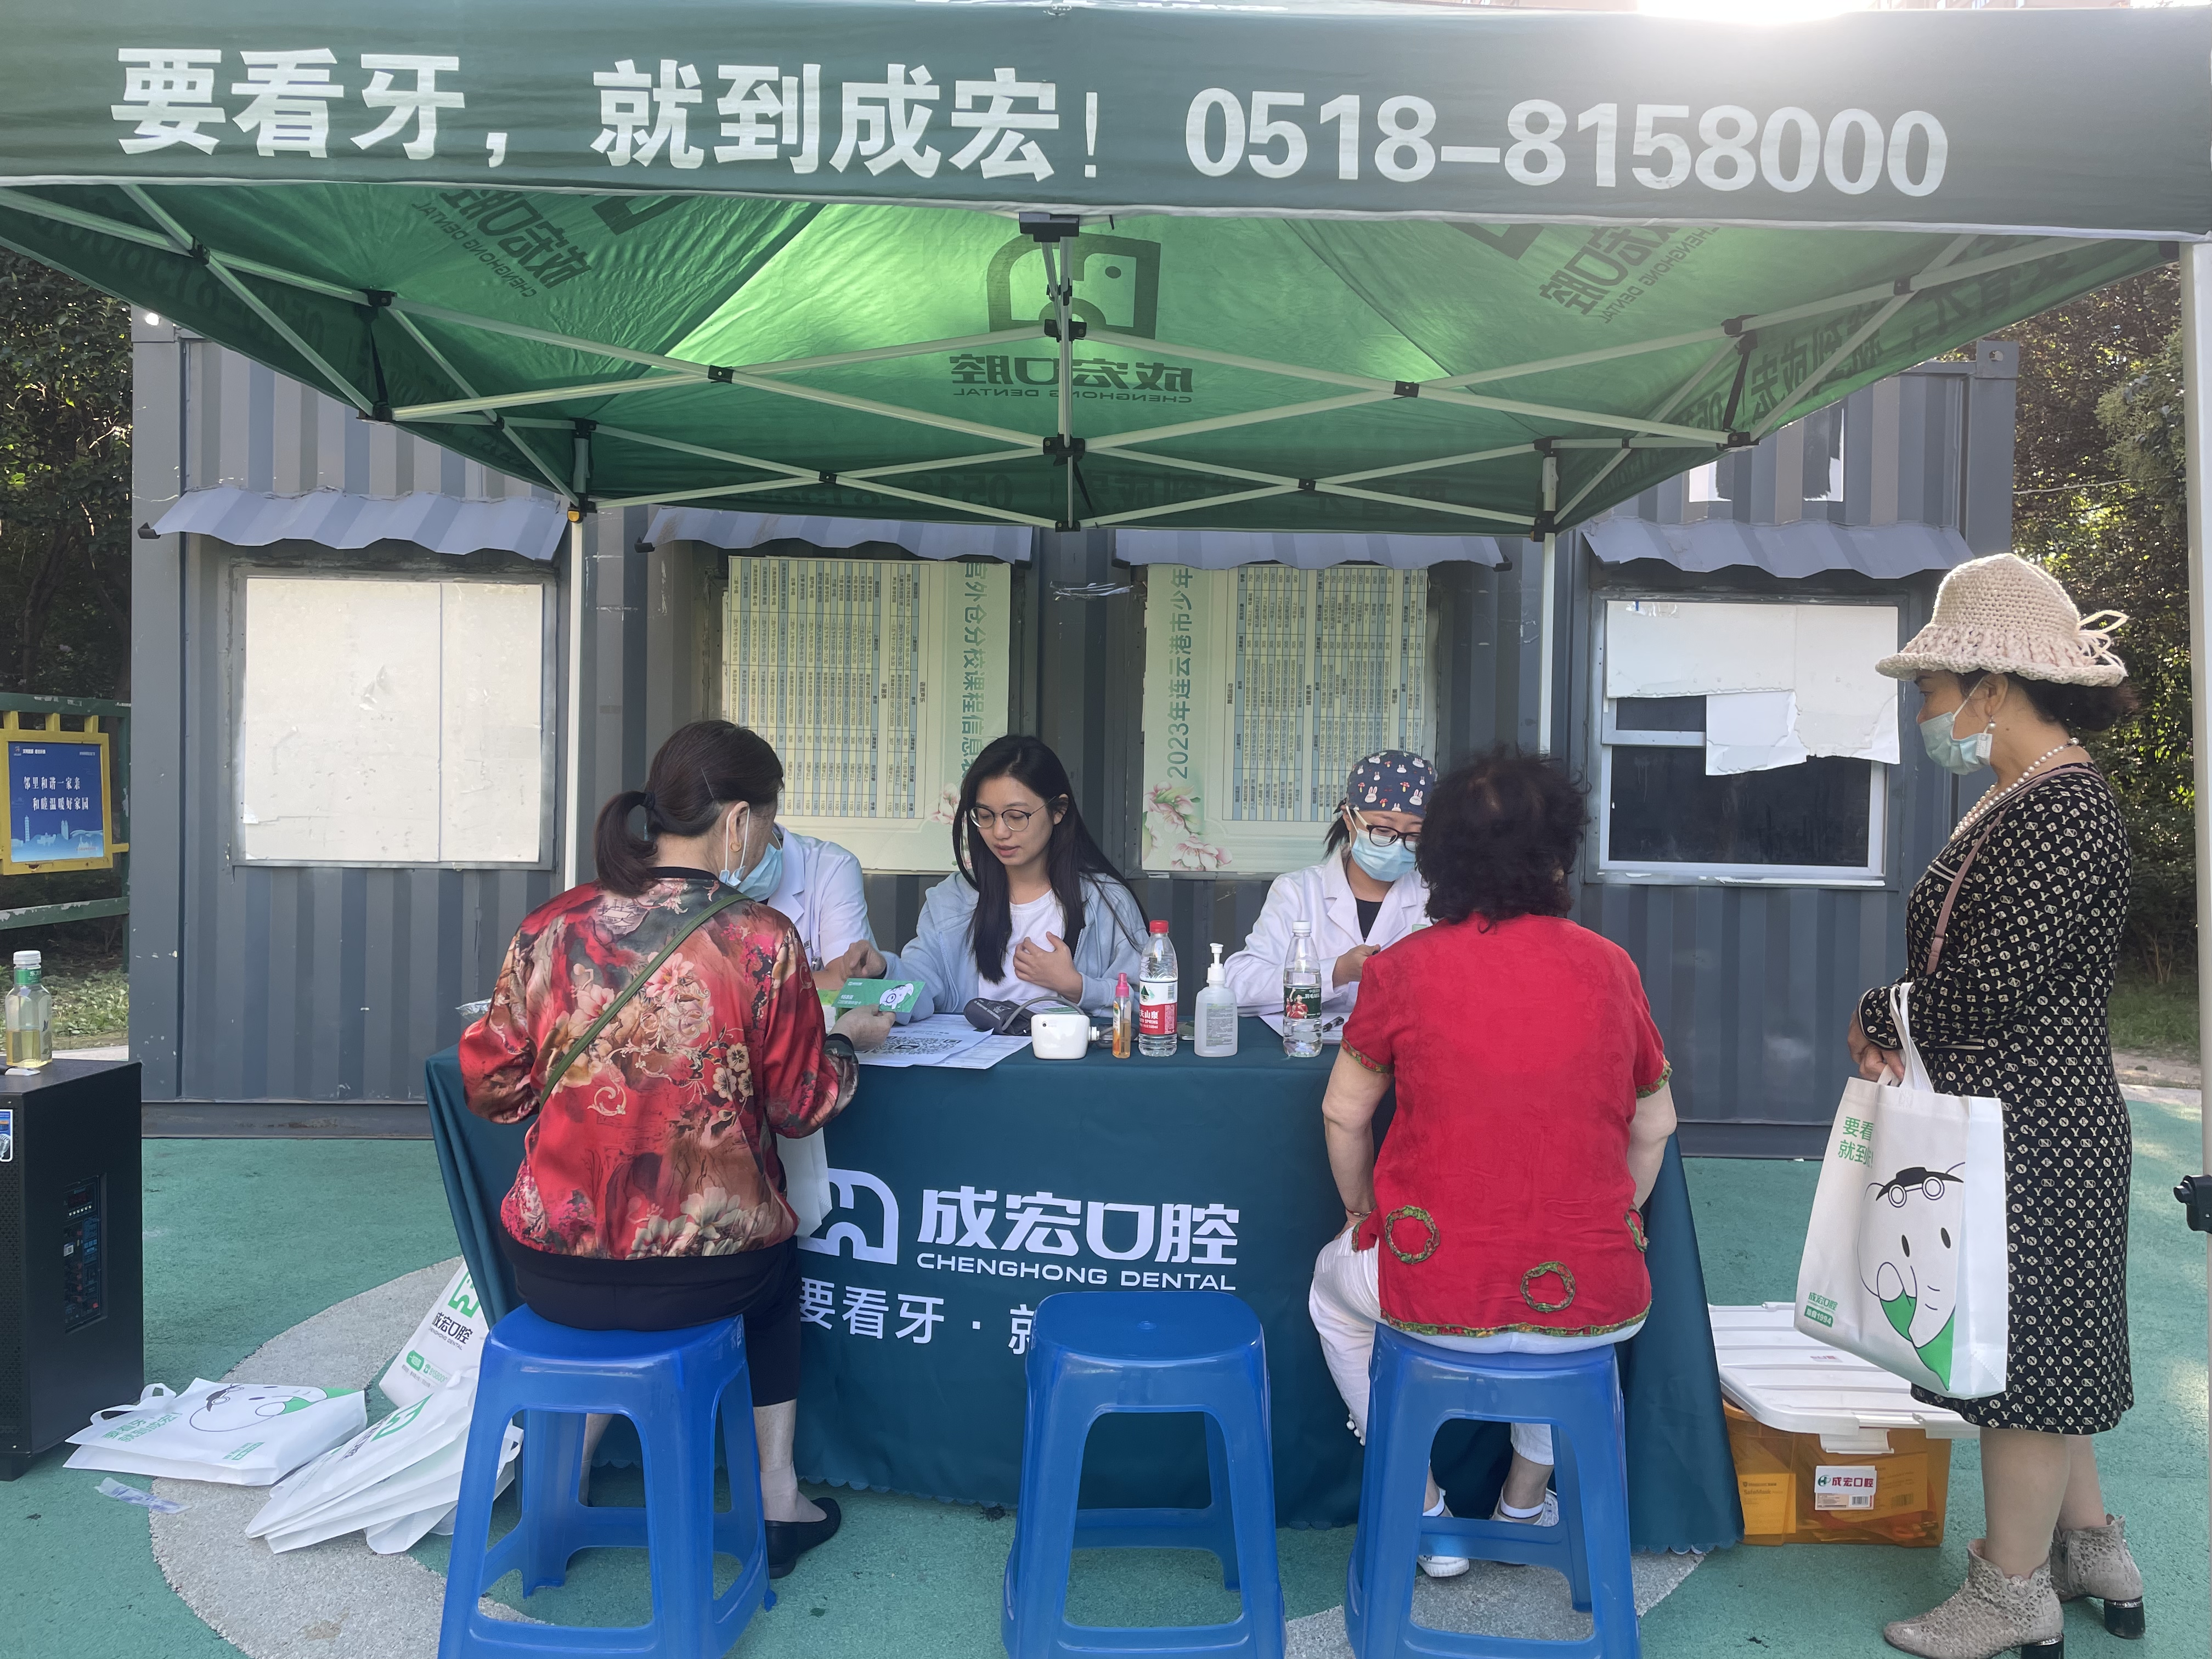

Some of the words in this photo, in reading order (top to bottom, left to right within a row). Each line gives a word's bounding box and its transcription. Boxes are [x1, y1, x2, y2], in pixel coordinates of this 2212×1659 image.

[917, 1185, 1239, 1265] 成宏口腔
[916, 1252, 1108, 1285] CHENGHONG
[1120, 1271, 1237, 1291] DENTAL
[1832, 1477, 1874, 1488] 成宏口腔
